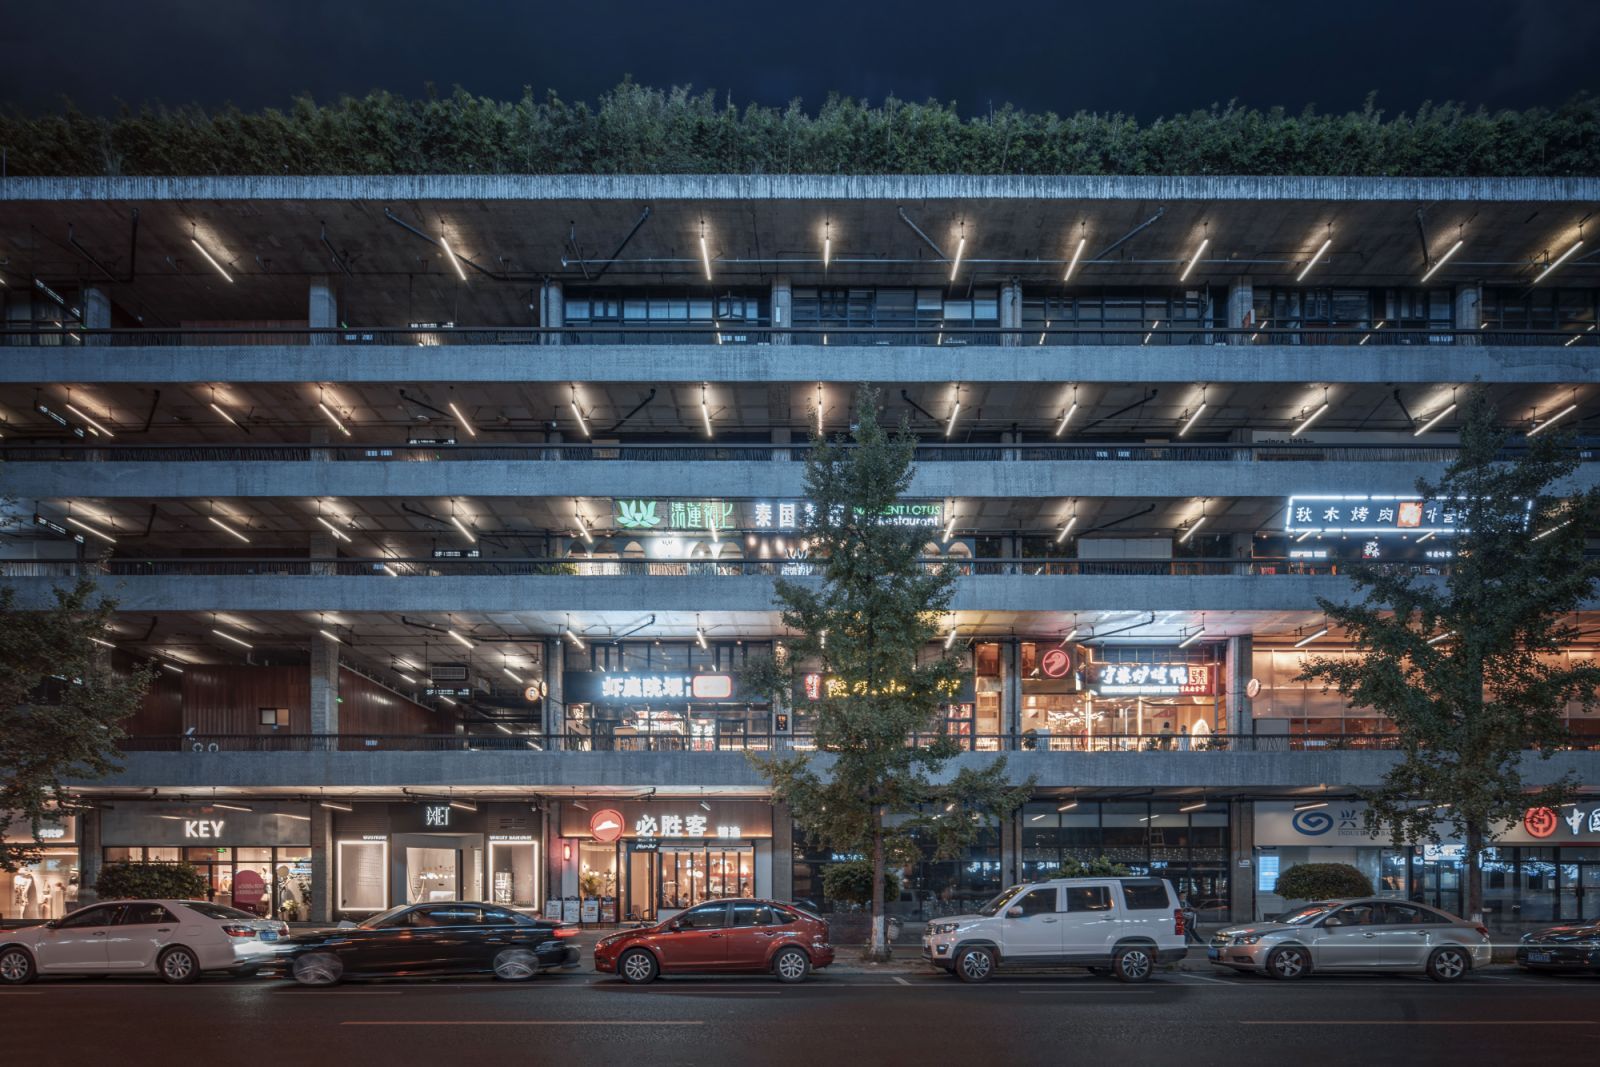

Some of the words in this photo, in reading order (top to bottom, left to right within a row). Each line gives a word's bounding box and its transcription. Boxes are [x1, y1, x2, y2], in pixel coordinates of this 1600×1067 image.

[906, 505, 941, 515] LOTUS
[1295, 506, 1394, 523] 秋木烤肉
[184, 820, 225, 838] KEY
[635, 814, 708, 837] 必胜客
